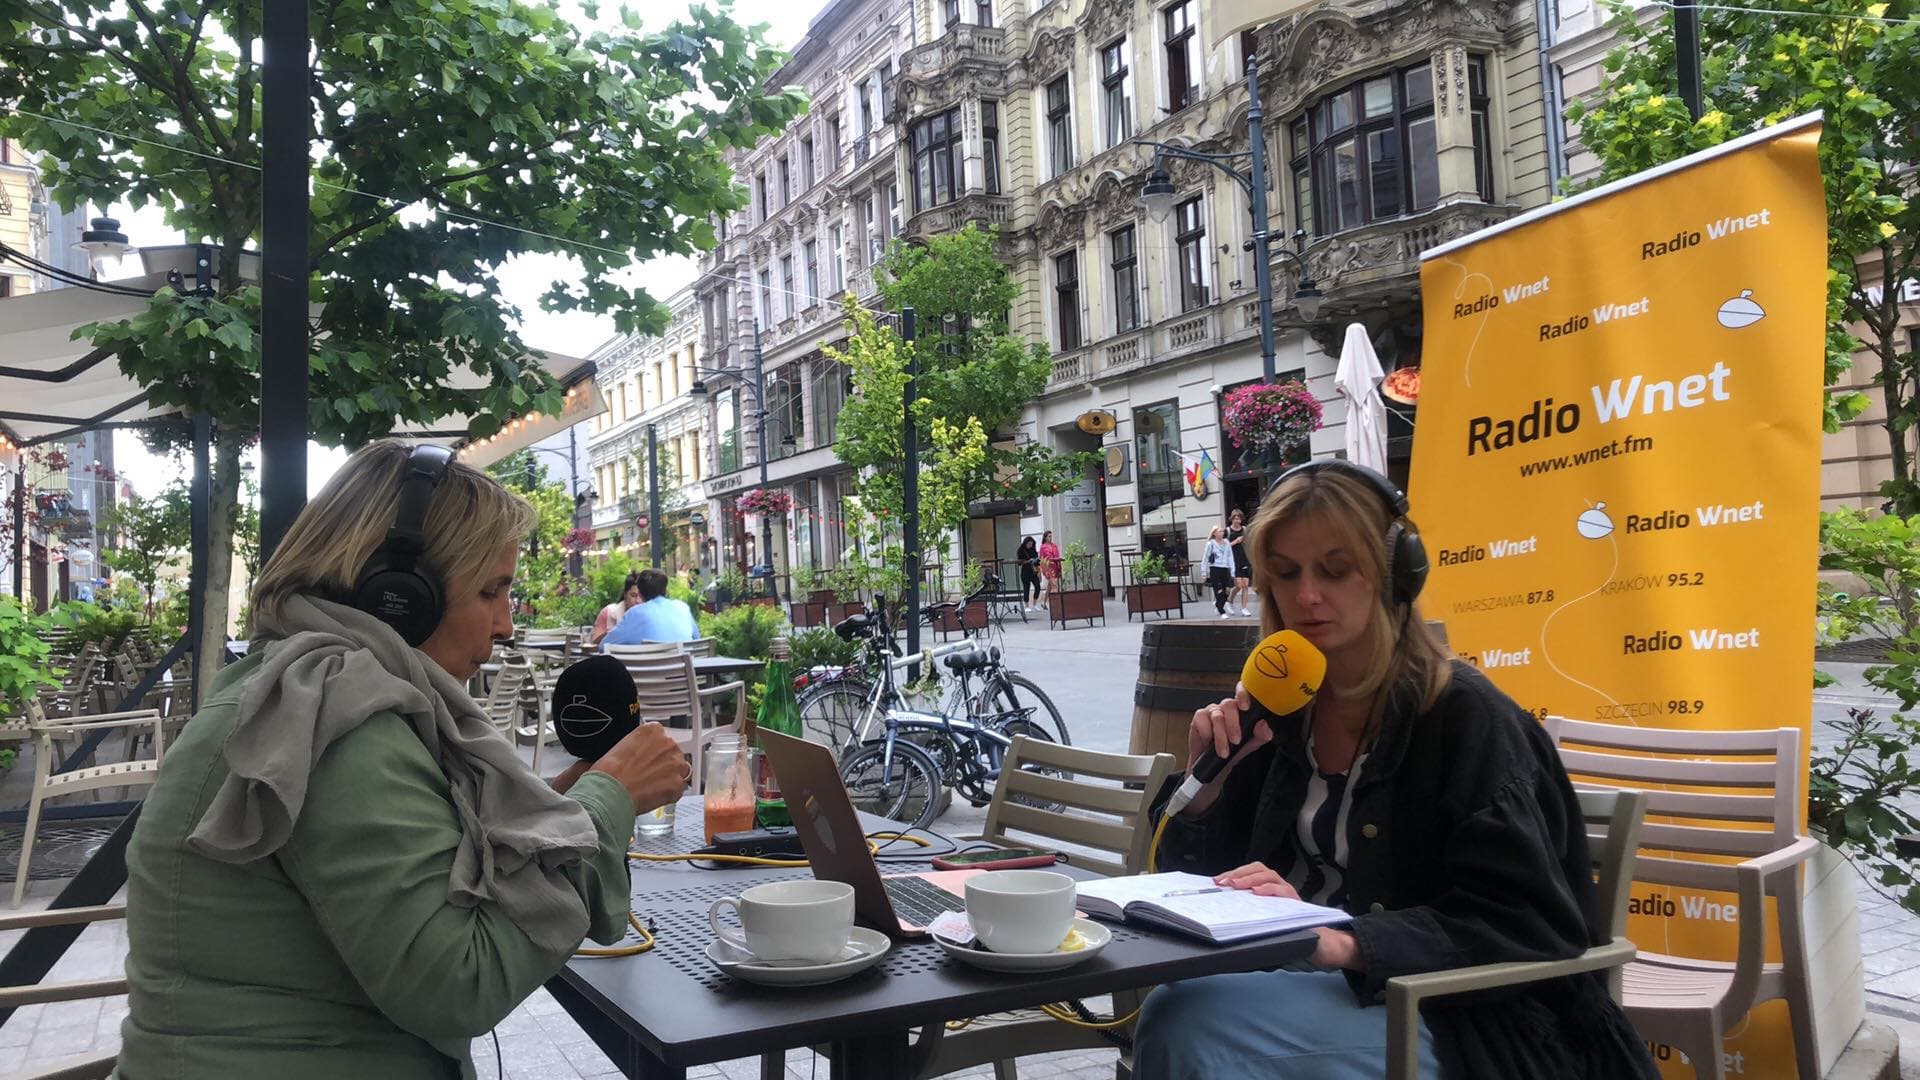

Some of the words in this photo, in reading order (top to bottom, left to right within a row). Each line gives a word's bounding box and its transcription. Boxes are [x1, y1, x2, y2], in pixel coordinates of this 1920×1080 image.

[1641, 229, 1701, 260] Radio
[1706, 208, 1771, 241] Wnet
[1453, 292, 1499, 320] Radio
[1503, 275, 1551, 305] Wnet
[1539, 313, 1589, 342] Radio
[1592, 296, 1650, 325] Wnet
[1467, 397, 1581, 457] Radio
[1591, 361, 1731, 424] Wnet
[1520, 435, 1653, 478] www.wnet.fm
[1625, 510, 1690, 535] Radio
[1696, 500, 1765, 528] Wnet
[1438, 545, 1485, 567] Radio
[1489, 535, 1538, 559] Wnet
[1667, 572, 1704, 587] 95.2
[1452, 594, 1525, 615] WARSZAWA
[1527, 589, 1555, 605] 87.8
[1623, 630, 1683, 656] Radio
[1689, 627, 1760, 652] Wnet
[1481, 647, 1532, 669] Wnet
[1594, 701, 1663, 721] SZCZECIN
[1667, 699, 1704, 715] 98.9
[1628, 893, 1676, 918] adio
[1680, 895, 1739, 922] Wne
